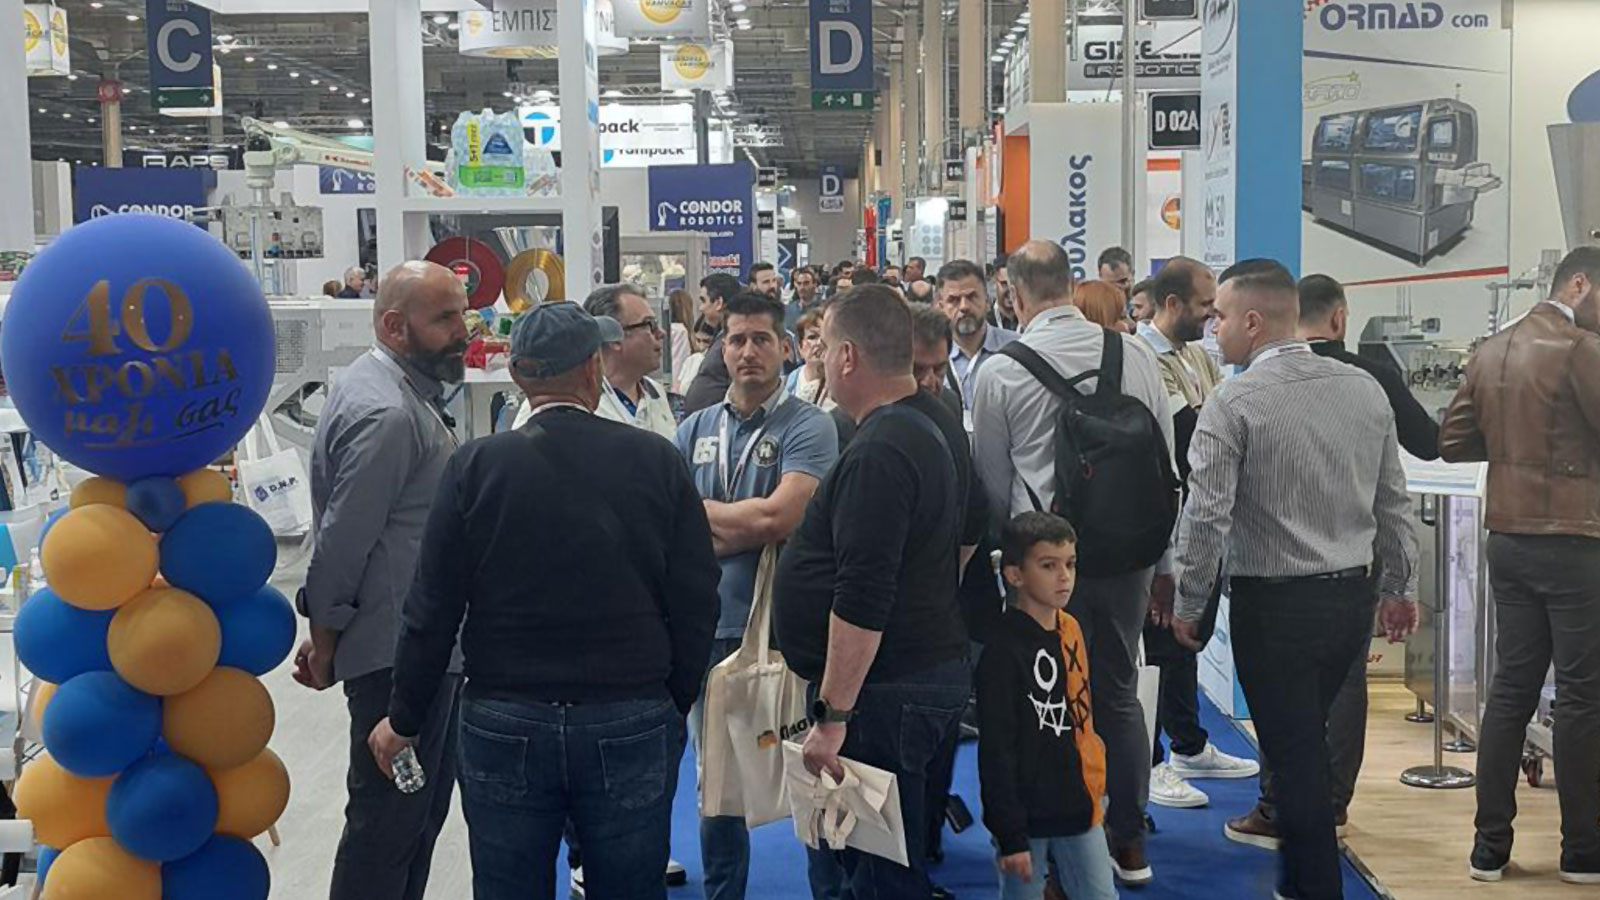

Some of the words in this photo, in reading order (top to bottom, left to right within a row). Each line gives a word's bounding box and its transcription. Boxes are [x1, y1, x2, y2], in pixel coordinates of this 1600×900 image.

[1319, 3, 1444, 31] ORMAD
[156, 19, 201, 73] C
[819, 21, 863, 74] D
[1155, 110, 1166, 132] D
[1169, 110, 1199, 131] 02A
[679, 200, 742, 214] CONDOR
[679, 215, 744, 225] ROBOTICS
[61, 276, 194, 355] 40
